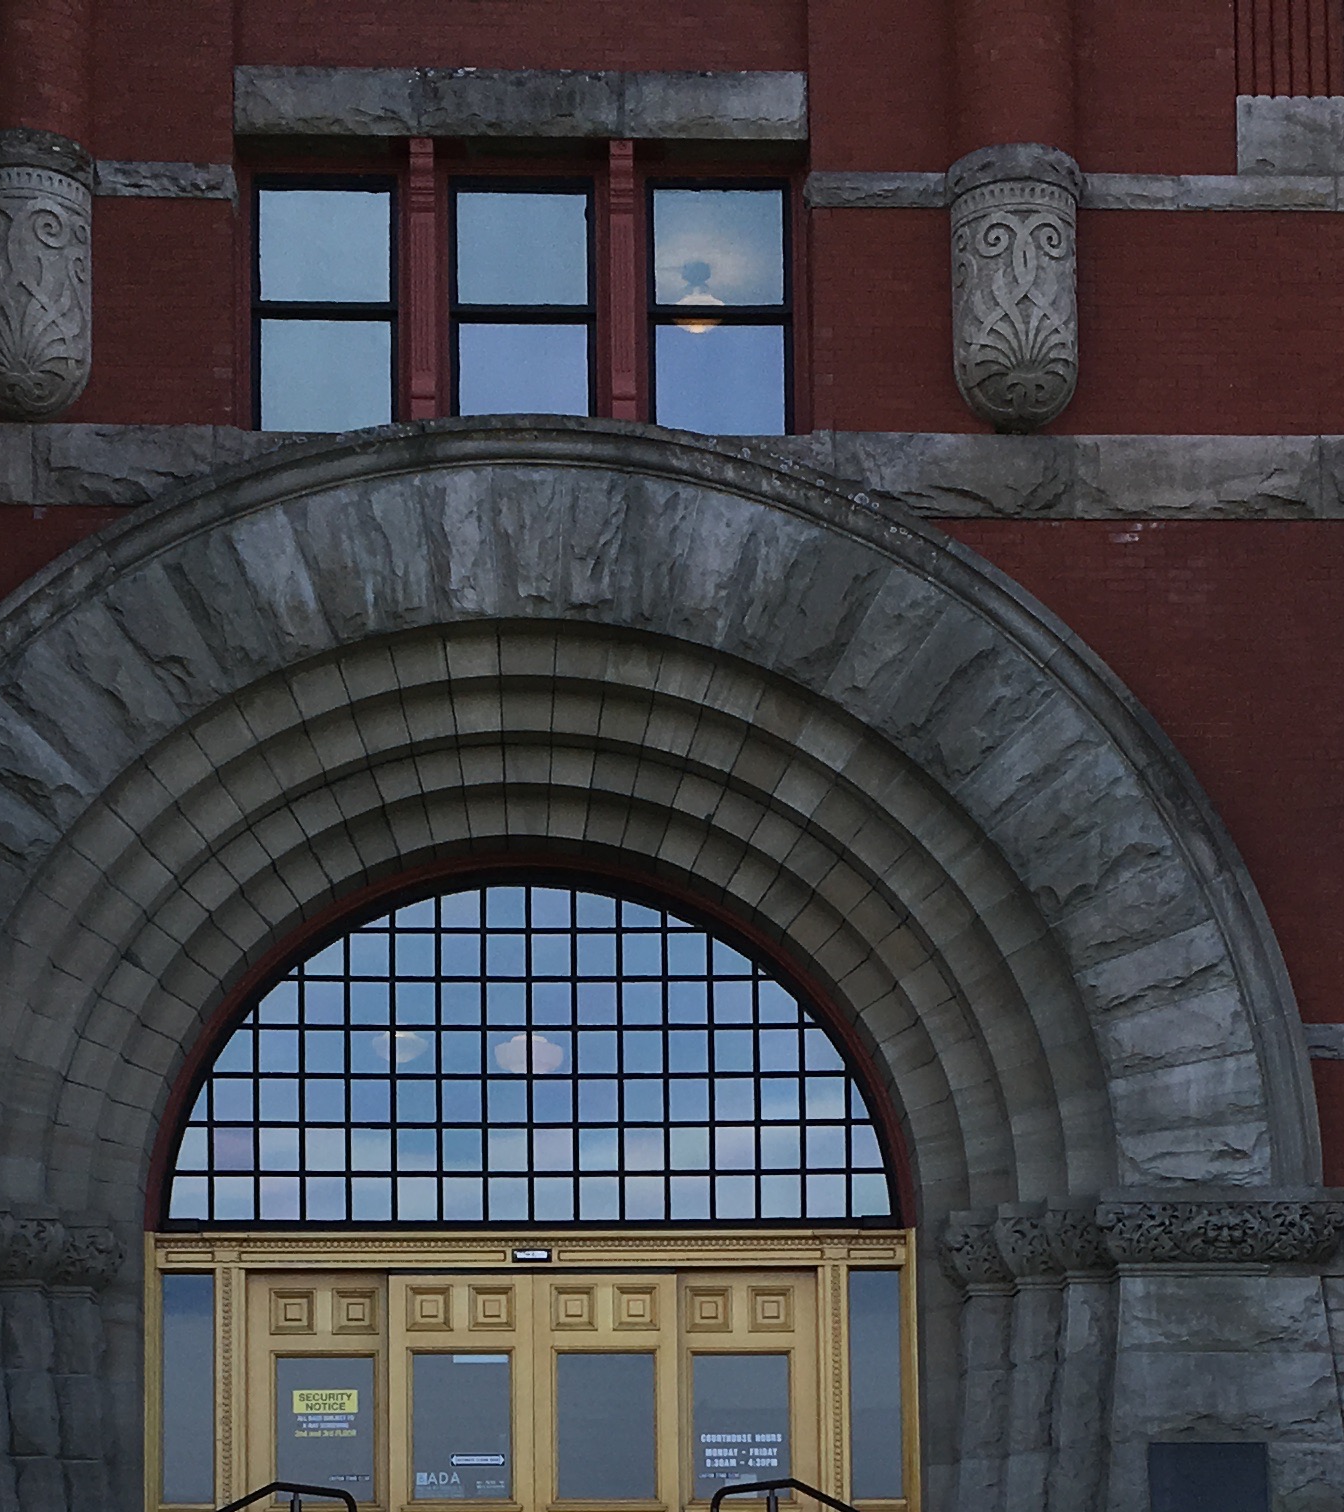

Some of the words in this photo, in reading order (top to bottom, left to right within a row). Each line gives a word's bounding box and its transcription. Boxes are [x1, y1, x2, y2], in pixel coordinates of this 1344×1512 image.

[298, 1392, 352, 1402] SECURITY
[305, 1402, 346, 1412] NOTICE
[700, 1433, 752, 1443] COURTHOUSE
[754, 1433, 782, 1443] HOURS
[705, 1448, 738, 1457] MONDAY
[749, 1447, 777, 1456] FRIDAY
[427, 1471, 461, 1485] ADA
